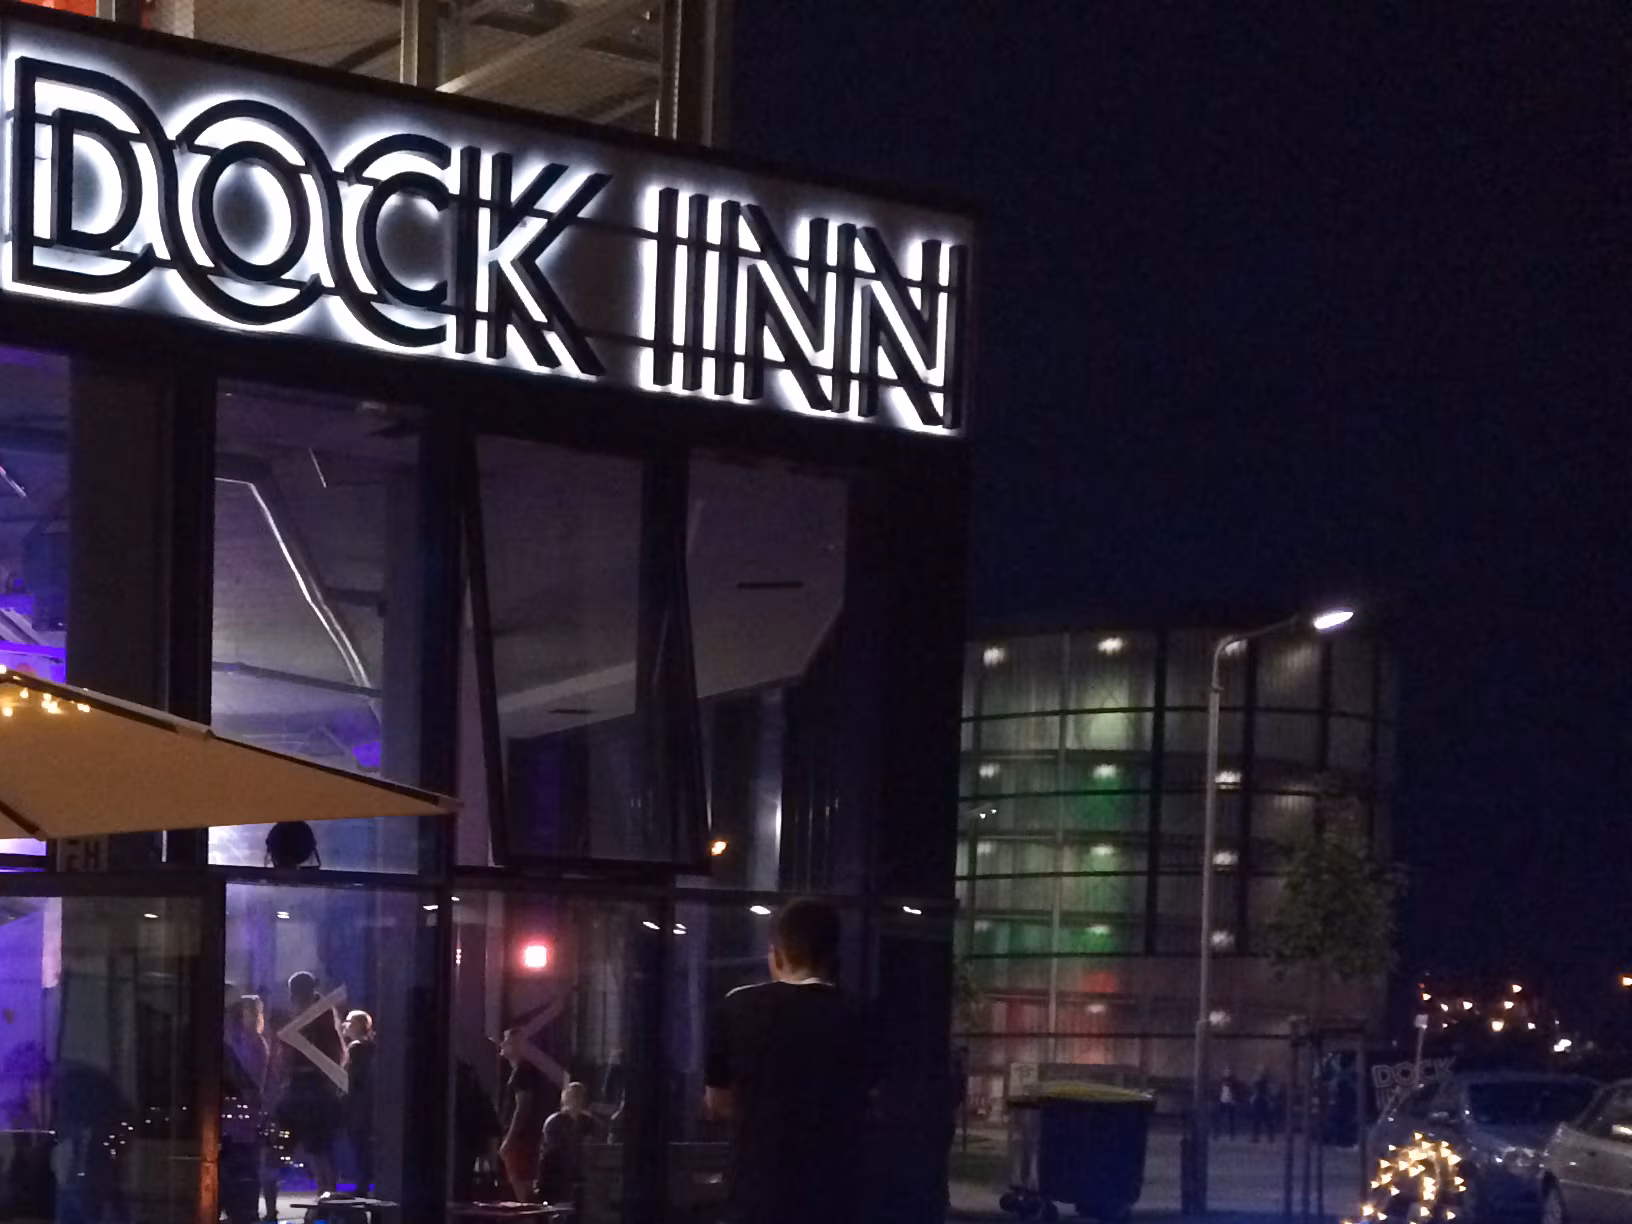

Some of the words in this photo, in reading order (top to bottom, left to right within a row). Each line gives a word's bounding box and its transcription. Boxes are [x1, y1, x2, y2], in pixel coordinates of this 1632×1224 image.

[11, 55, 612, 376] DOCK
[653, 186, 967, 431] INN
[1371, 1056, 1457, 1089] DOCK
